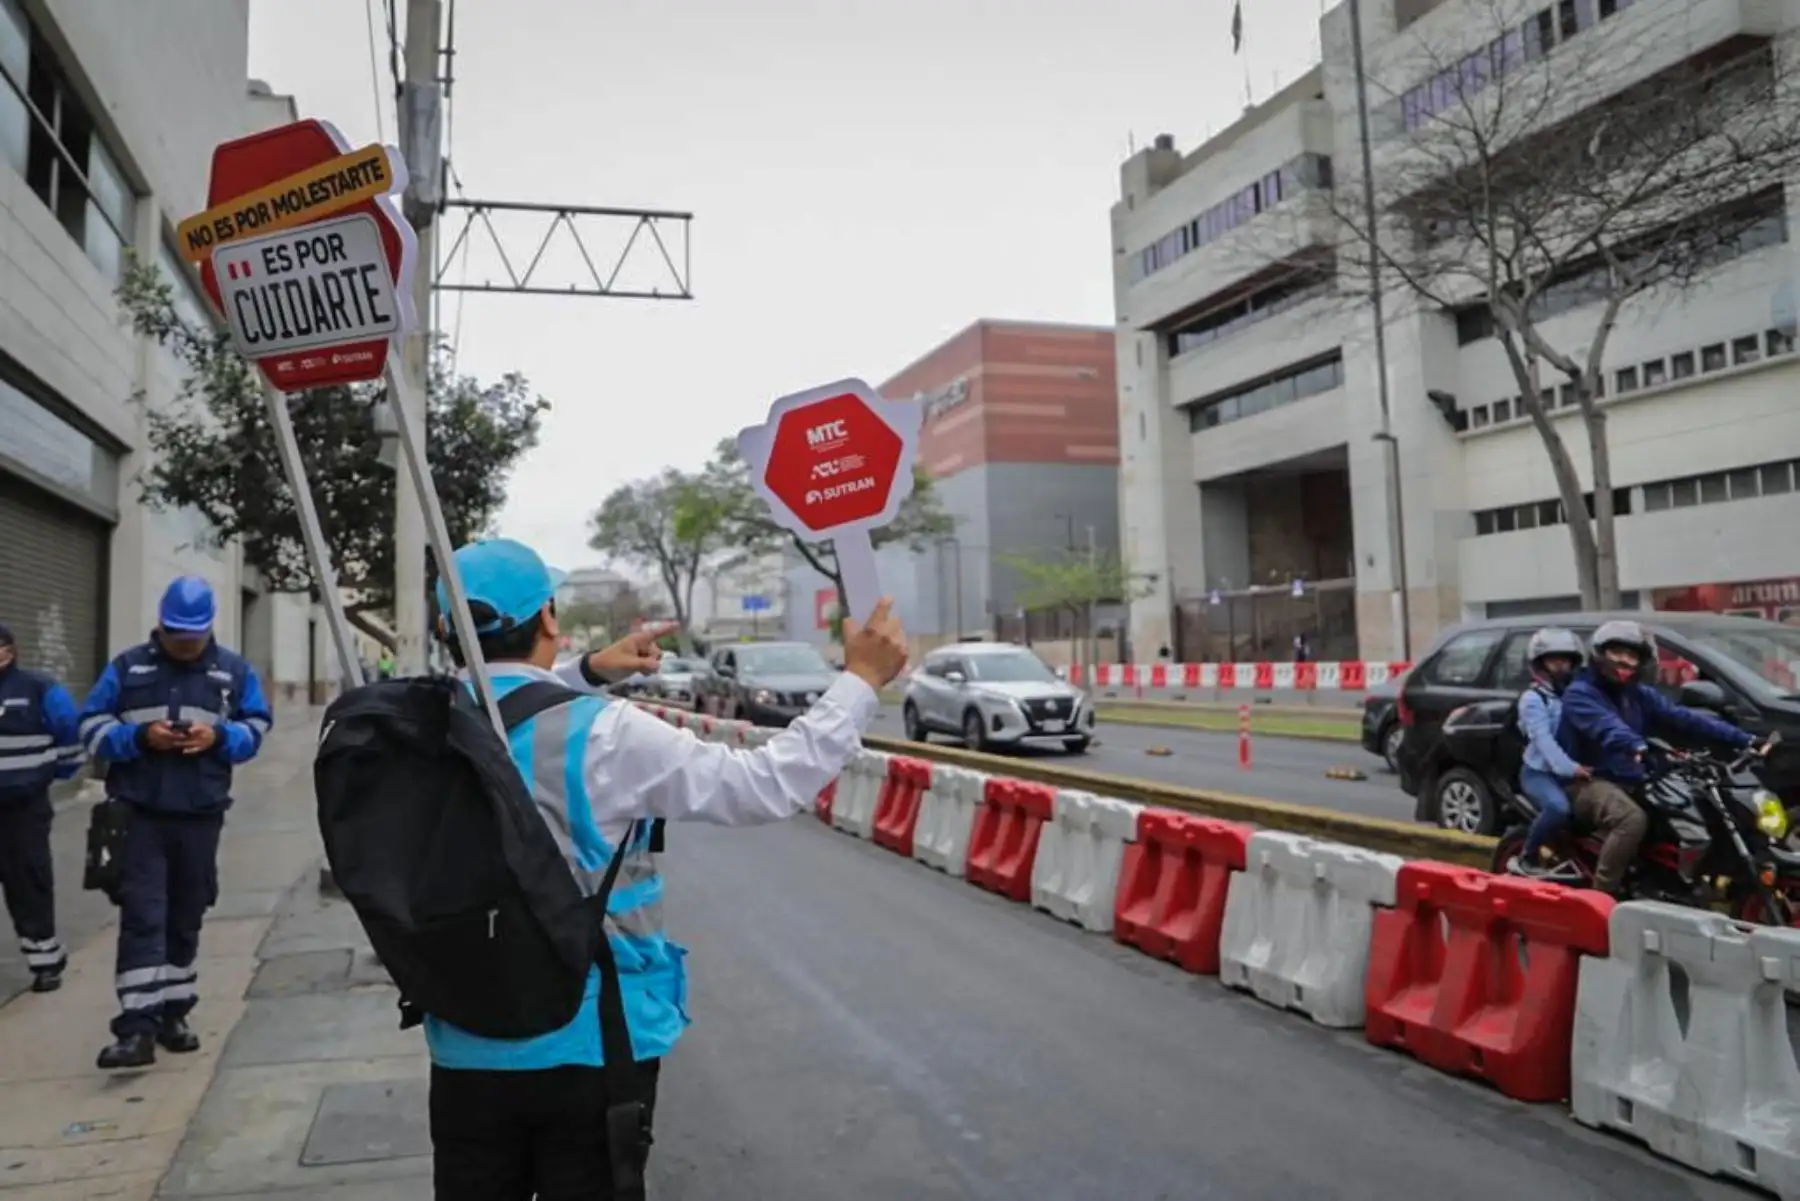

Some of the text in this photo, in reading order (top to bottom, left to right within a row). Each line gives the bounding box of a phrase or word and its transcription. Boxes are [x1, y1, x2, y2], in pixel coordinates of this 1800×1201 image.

[187, 157, 384, 250] NO ES POR MOLESTARTE
[261, 232, 347, 276] ES POR
[233, 263, 391, 344] CUIDARTE
[806, 418, 848, 446] MTC
[823, 476, 876, 501] SUTRAN
